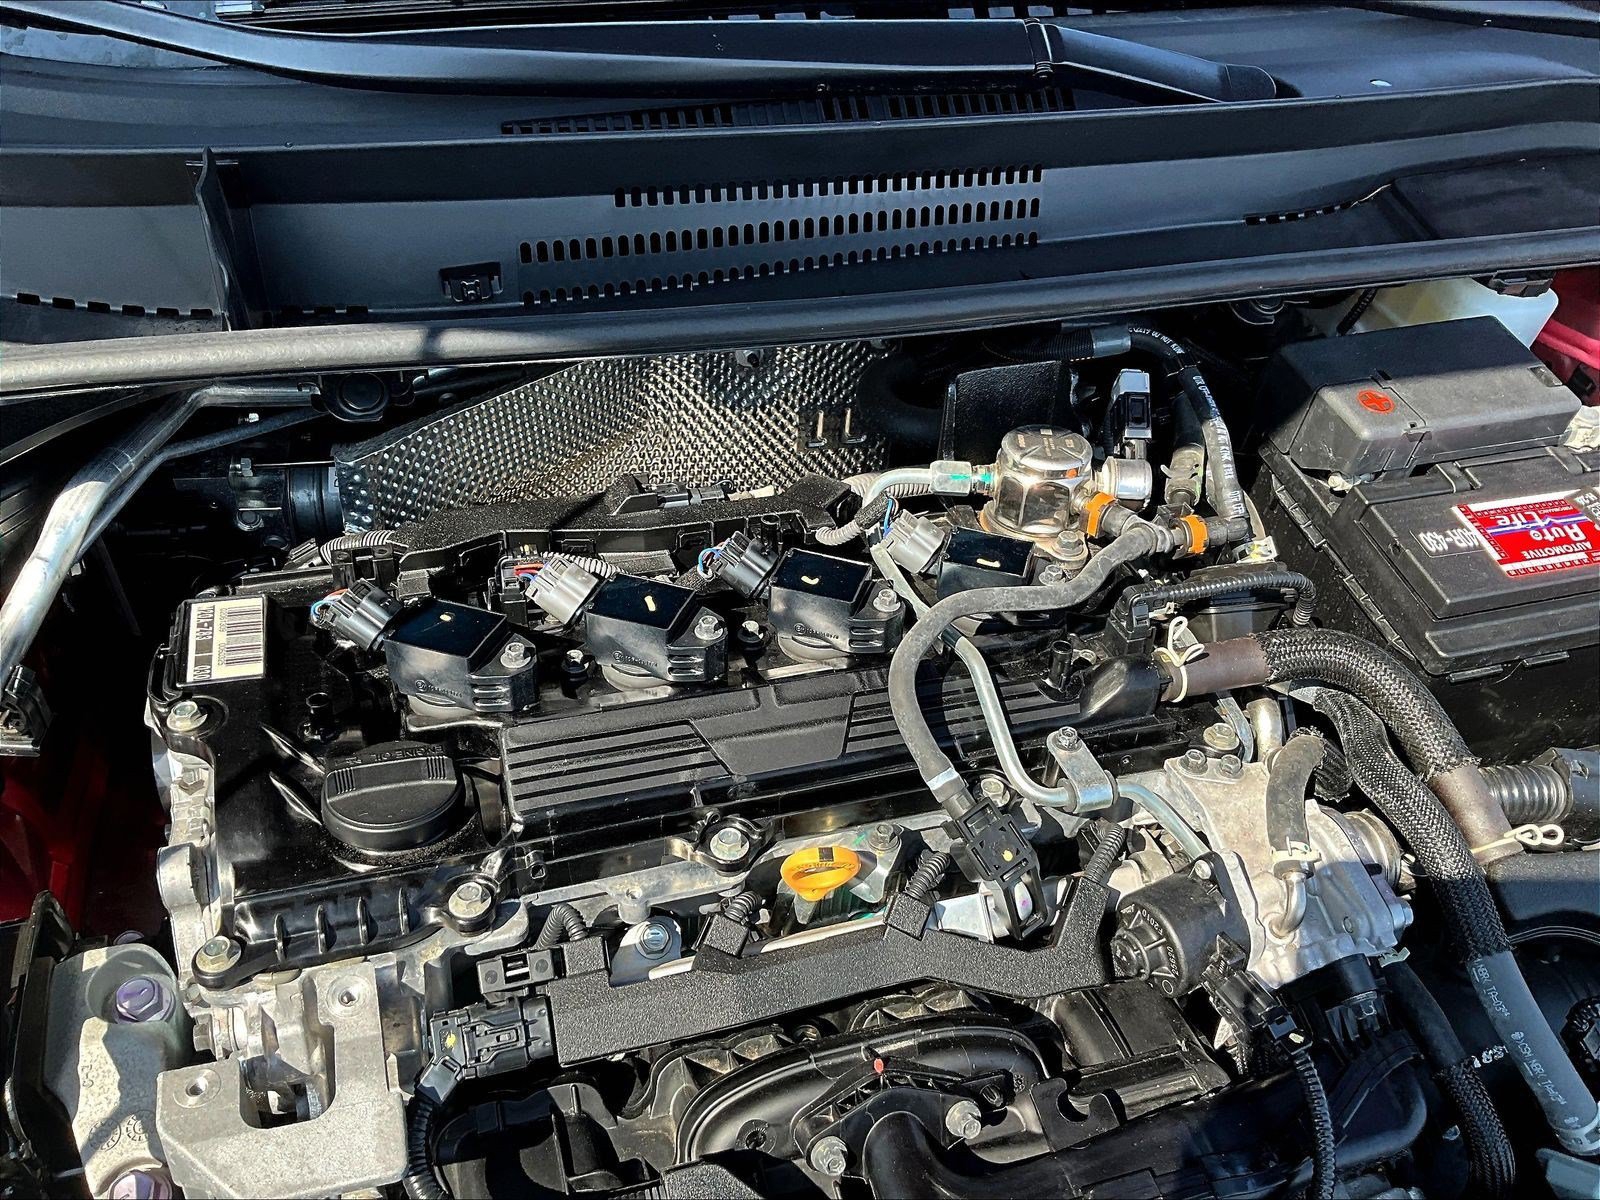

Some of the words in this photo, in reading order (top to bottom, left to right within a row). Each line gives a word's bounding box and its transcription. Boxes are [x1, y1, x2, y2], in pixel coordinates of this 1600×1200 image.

[1530, 523, 1588, 543] Auto
[1520, 541, 1593, 560] AUTOMOTIVE
[370, 752, 391, 763] OIL
[396, 745, 444, 760] ENGINE
